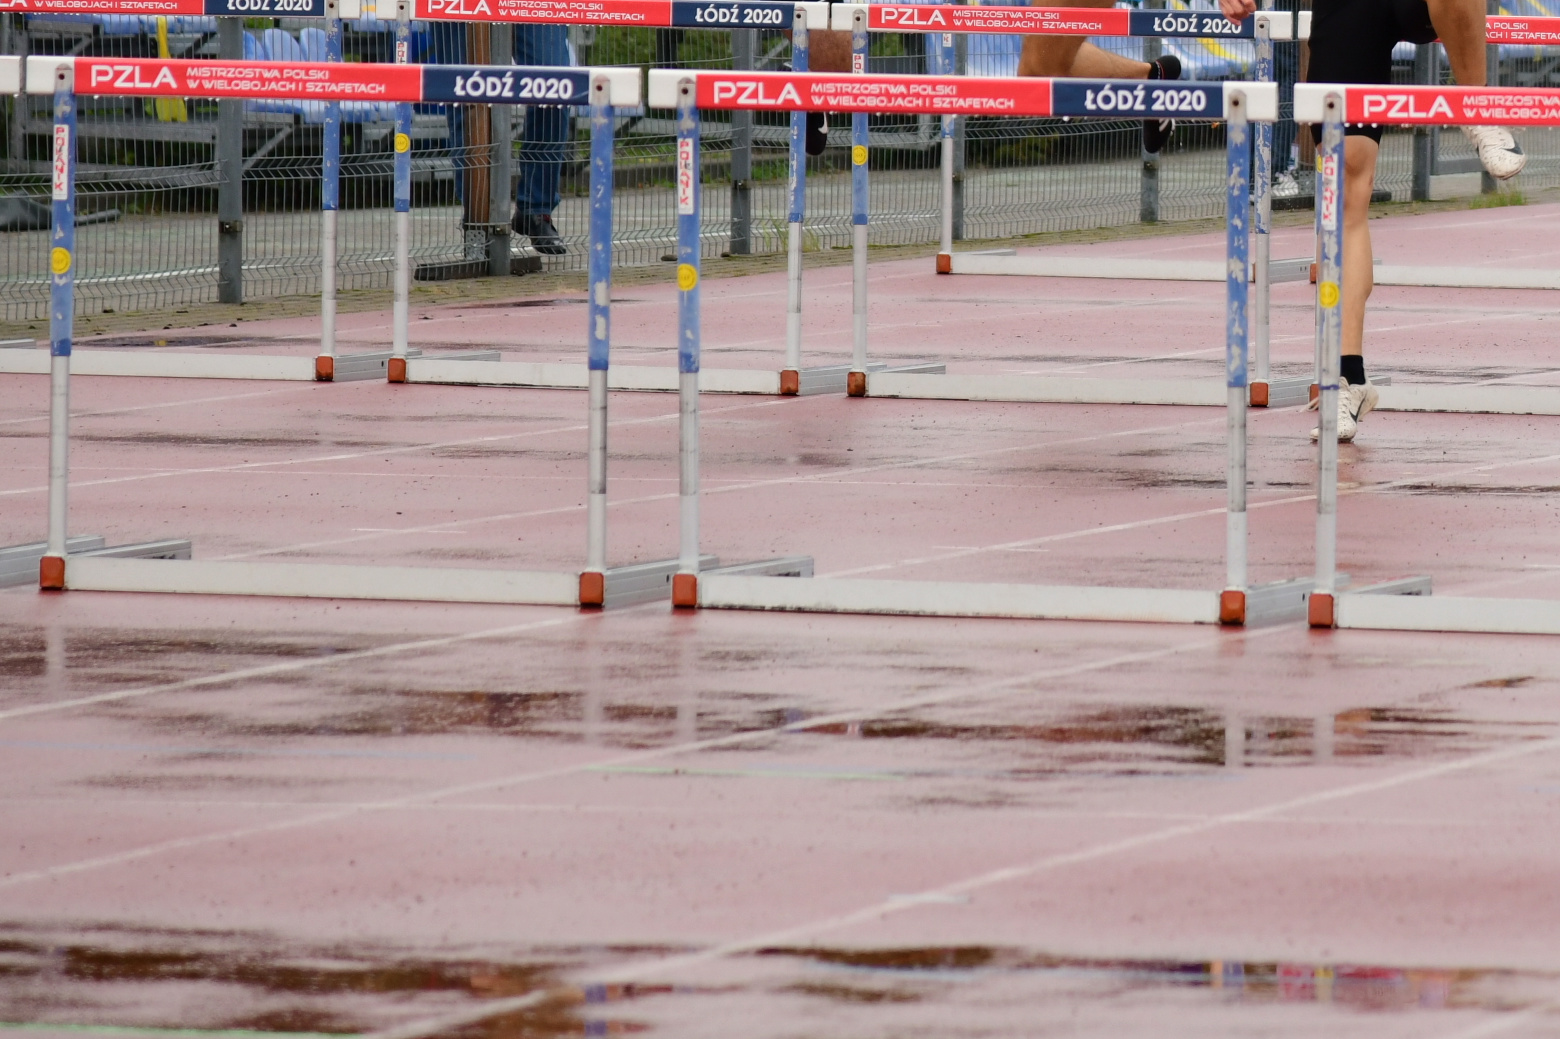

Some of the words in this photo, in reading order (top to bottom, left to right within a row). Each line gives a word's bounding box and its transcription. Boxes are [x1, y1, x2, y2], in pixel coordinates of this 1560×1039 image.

[33, 0, 44, 8] W
[44, 0, 113, 9] WIELOBOJACH
[119, 1, 178, 10] SZTAFETACH
[497, 0, 569, 9] MISTRZOSTWA
[569, 2, 603, 11] POLSKI
[497, 8, 508, 16] W
[509, 9, 579, 19] WIELOBOJACH
[585, 11, 645, 21] SZTAFETACH
[695, 4, 739, 22] ŁÓDŹ
[743, 9, 782, 23] 2020
[882, 8, 946, 25] PZLA
[951, 9, 1025, 21] MISTRZOSTWA
[1025, 11, 1060, 20] POLSKI
[952, 18, 963, 26] W
[964, 19, 1035, 28] WIELOBOJACH
[1041, 21, 1102, 30] SZTAFETACH
[1153, 13, 1198, 33] ŁÓDŹ
[1202, 18, 1241, 33] 2020
[1493, 22, 1529, 30] POLSKI
[91, 65, 177, 88] PZLA
[185, 67, 282, 78] MISTRZOSTWA
[282, 68, 329, 80] POLSKI
[186, 78, 201, 89] W
[201, 79, 297, 92] WIELOBOJACH
[305, 82, 386, 94] SZTAFETACH
[454, 71, 513, 97] ŁÓDŹ
[519, 78, 572, 99] 2020
[714, 81, 802, 104] PZLA
[810, 82, 909, 95] MISTRZOSTWA
[909, 84, 957, 96] POLSKI
[810, 95, 826, 105] W
[826, 95, 924, 108] WIELOBOJACH
[932, 97, 1015, 110] SZTAFETACH
[1085, 84, 1146, 110] ŁÓDŹ
[1152, 90, 1206, 111] 2020
[1364, 95, 1453, 118] PZLA
[1462, 107, 1478, 118] W
[55, 126, 65, 191] POLANIK
[1323, 155, 1335, 222] POANIK
